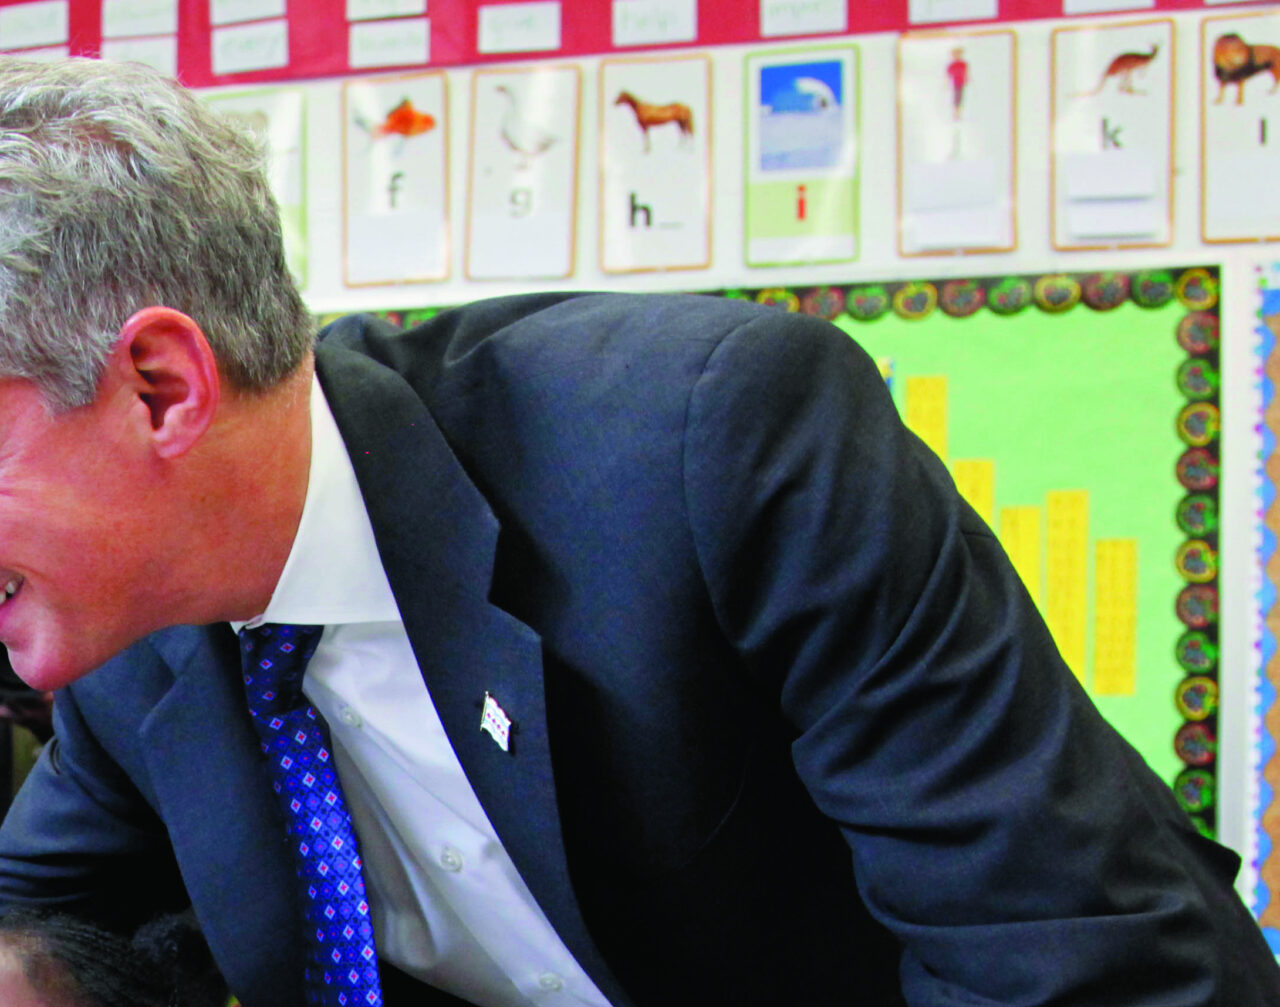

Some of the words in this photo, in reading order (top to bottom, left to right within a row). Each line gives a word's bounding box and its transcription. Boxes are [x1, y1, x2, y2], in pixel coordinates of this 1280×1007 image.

[1100, 117, 1123, 150] k
[387, 171, 405, 209] f
[508, 186, 533, 218] g
[795, 184, 807, 221] i
[627, 191, 653, 227] h
